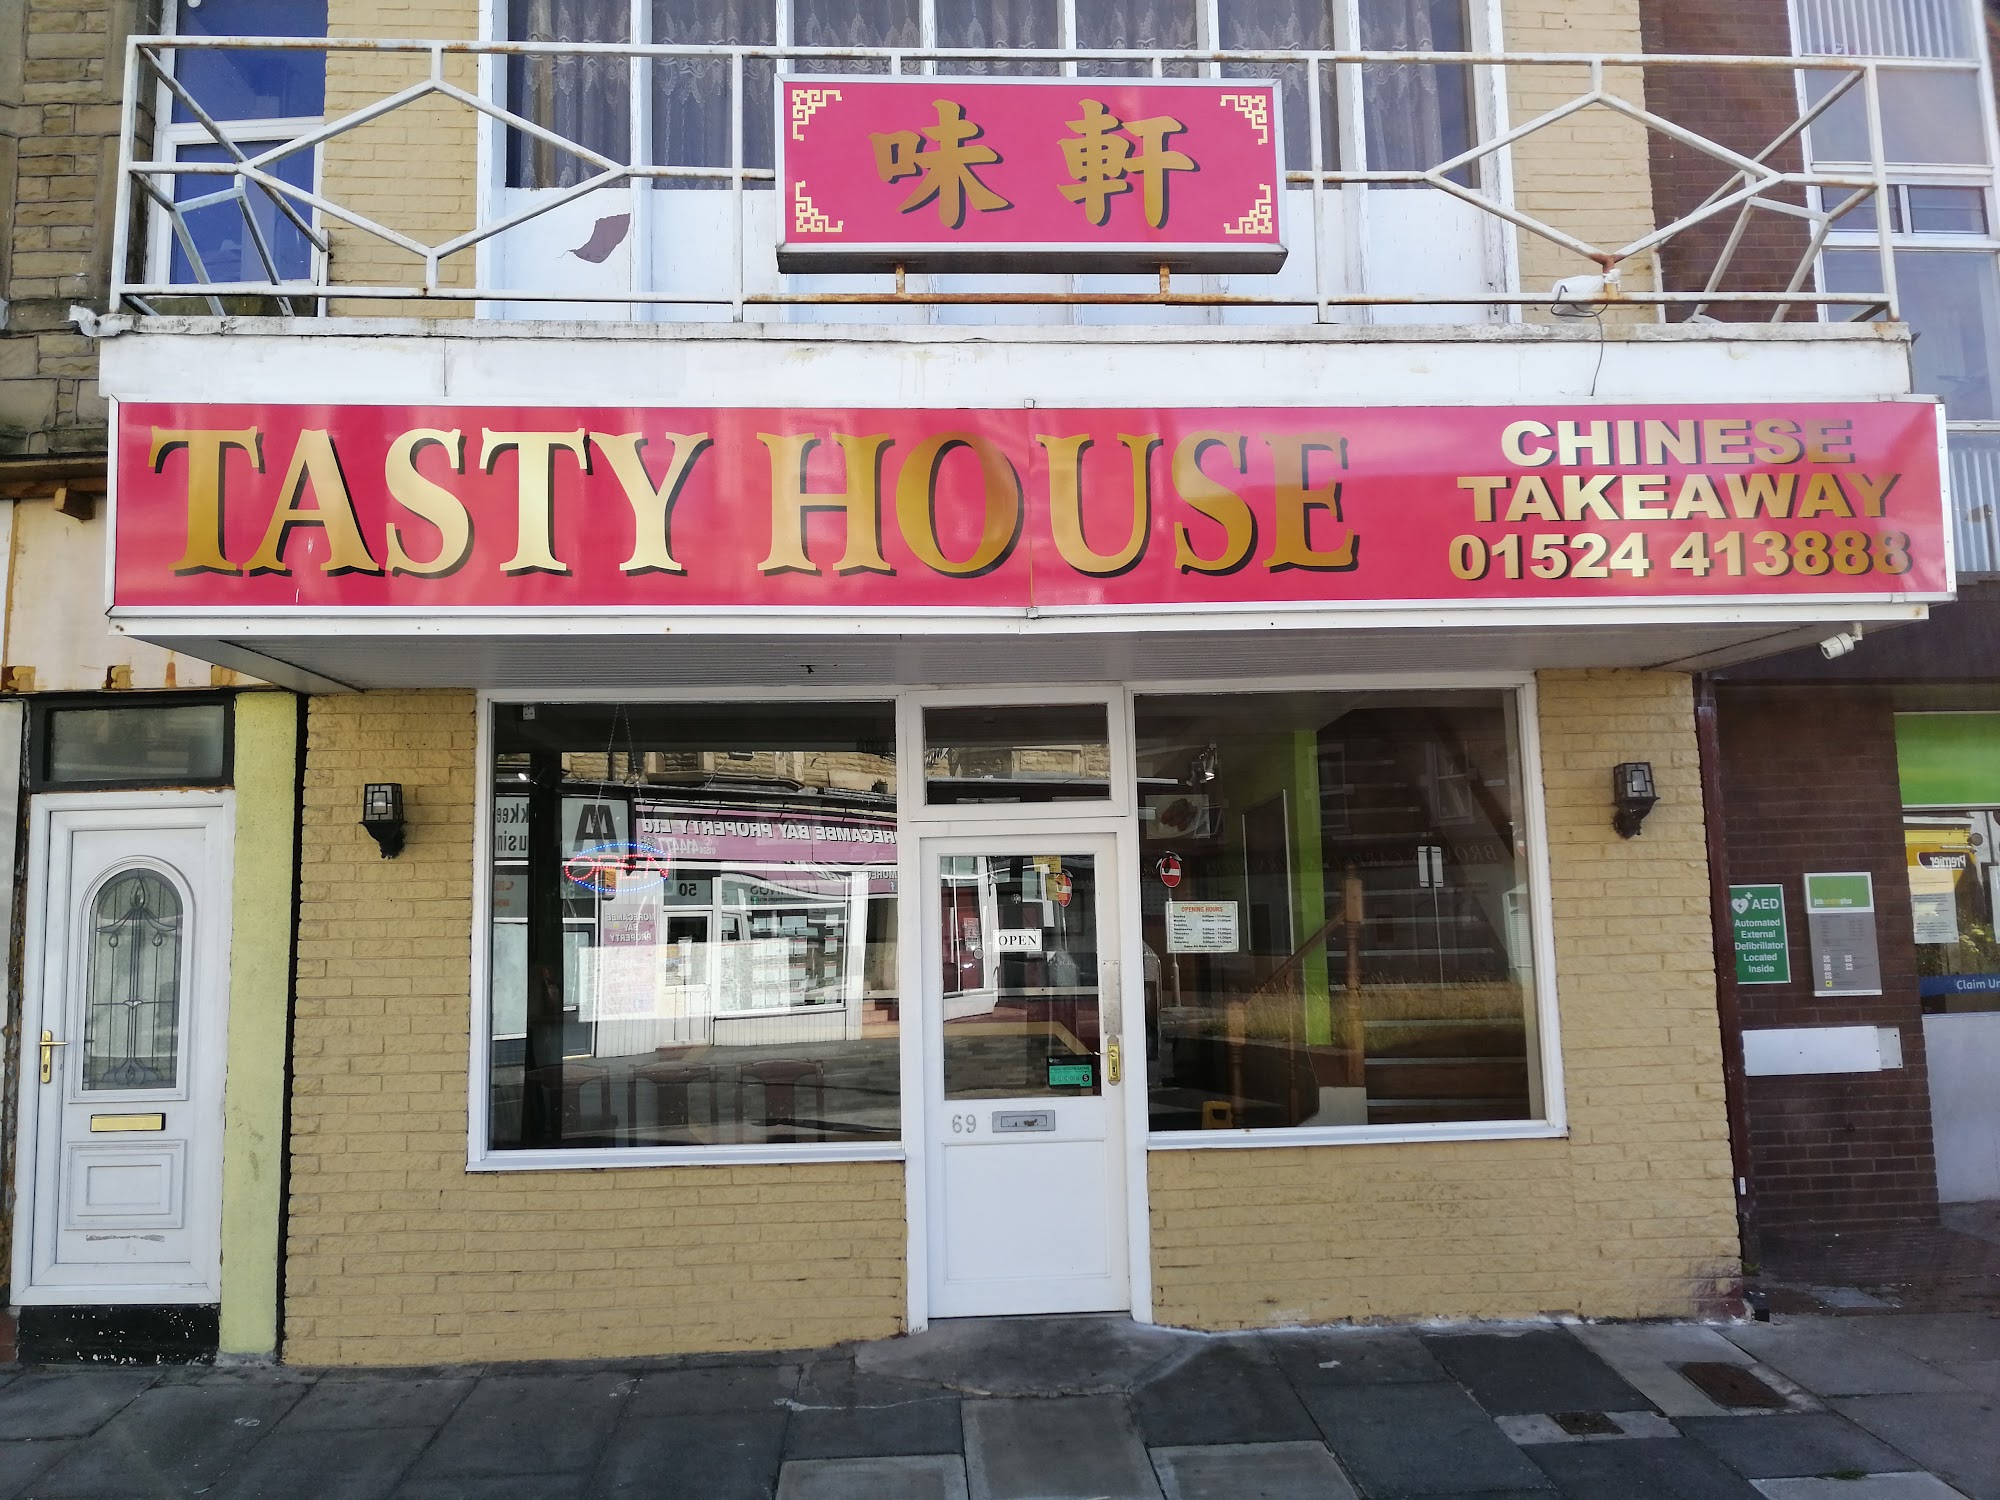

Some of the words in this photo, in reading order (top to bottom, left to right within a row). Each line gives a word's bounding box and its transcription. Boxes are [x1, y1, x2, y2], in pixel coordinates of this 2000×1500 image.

[868, 98, 1201, 229] 味軒
[1501, 418, 1855, 467] CHINESE
[148, 425, 714, 577] TASTY
[756, 429, 1359, 578] HOUSE
[1457, 472, 1901, 522] TAKEAWAY
[1449, 532, 1653, 580] 01524
[1670, 529, 1911, 576] 413888
[565, 853, 672, 881] OPEN
[1752, 898, 1779, 910] AED
[1734, 919, 1780, 928] Automated
[998, 934, 1038, 946] OPEN
[1741, 930, 1776, 939] External
[1734, 941, 1785, 951] Defibrillator
[1743, 952, 1778, 962] Located
[1748, 964, 1775, 973] Inside
[1956, 979, 1986, 990] Claim
[952, 1113, 977, 1134] 69
